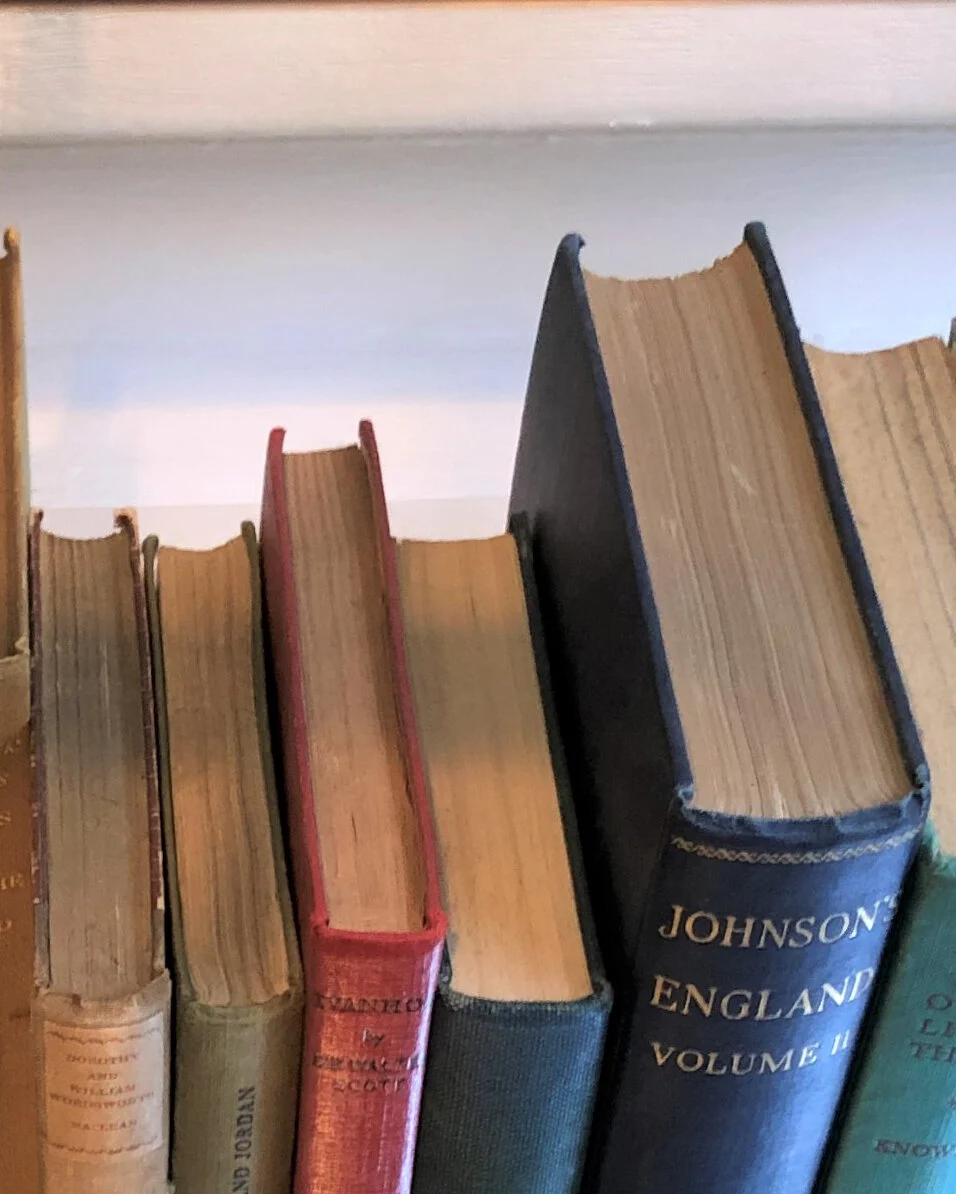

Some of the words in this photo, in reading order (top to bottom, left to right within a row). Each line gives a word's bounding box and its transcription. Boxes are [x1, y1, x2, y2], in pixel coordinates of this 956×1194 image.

[312, 991, 425, 1014] IVANHO
[650, 967, 874, 1021] ENGLAND
[650, 1041, 820, 1076] VOLUME
[87, 1072, 119, 1081] AND
